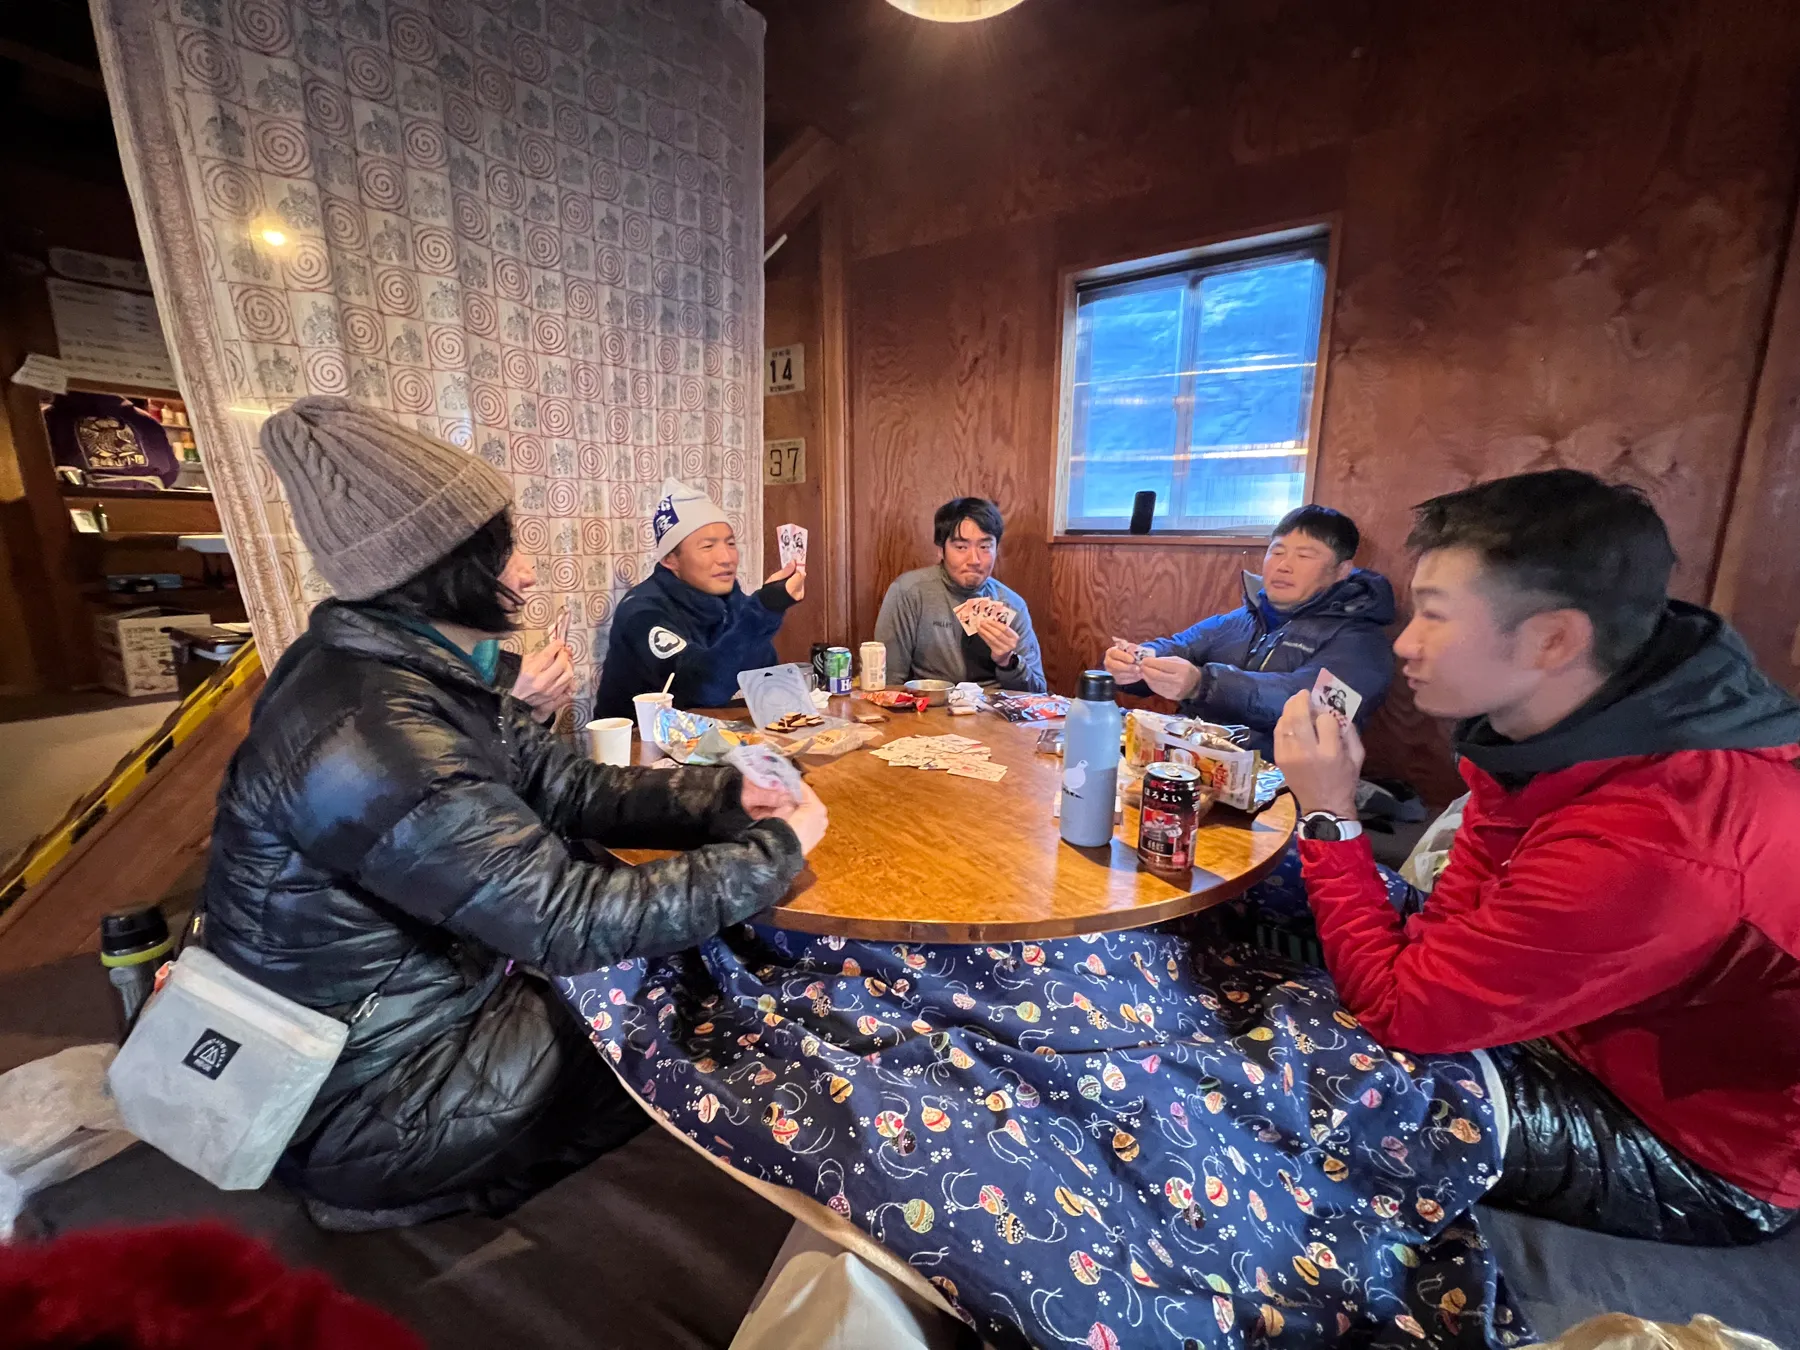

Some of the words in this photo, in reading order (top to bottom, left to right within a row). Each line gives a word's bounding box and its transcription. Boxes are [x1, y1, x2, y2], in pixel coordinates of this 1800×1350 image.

[769, 357, 793, 383] 14
[769, 447, 799, 477] 37
[1144, 788, 1182, 803] ほろよい
